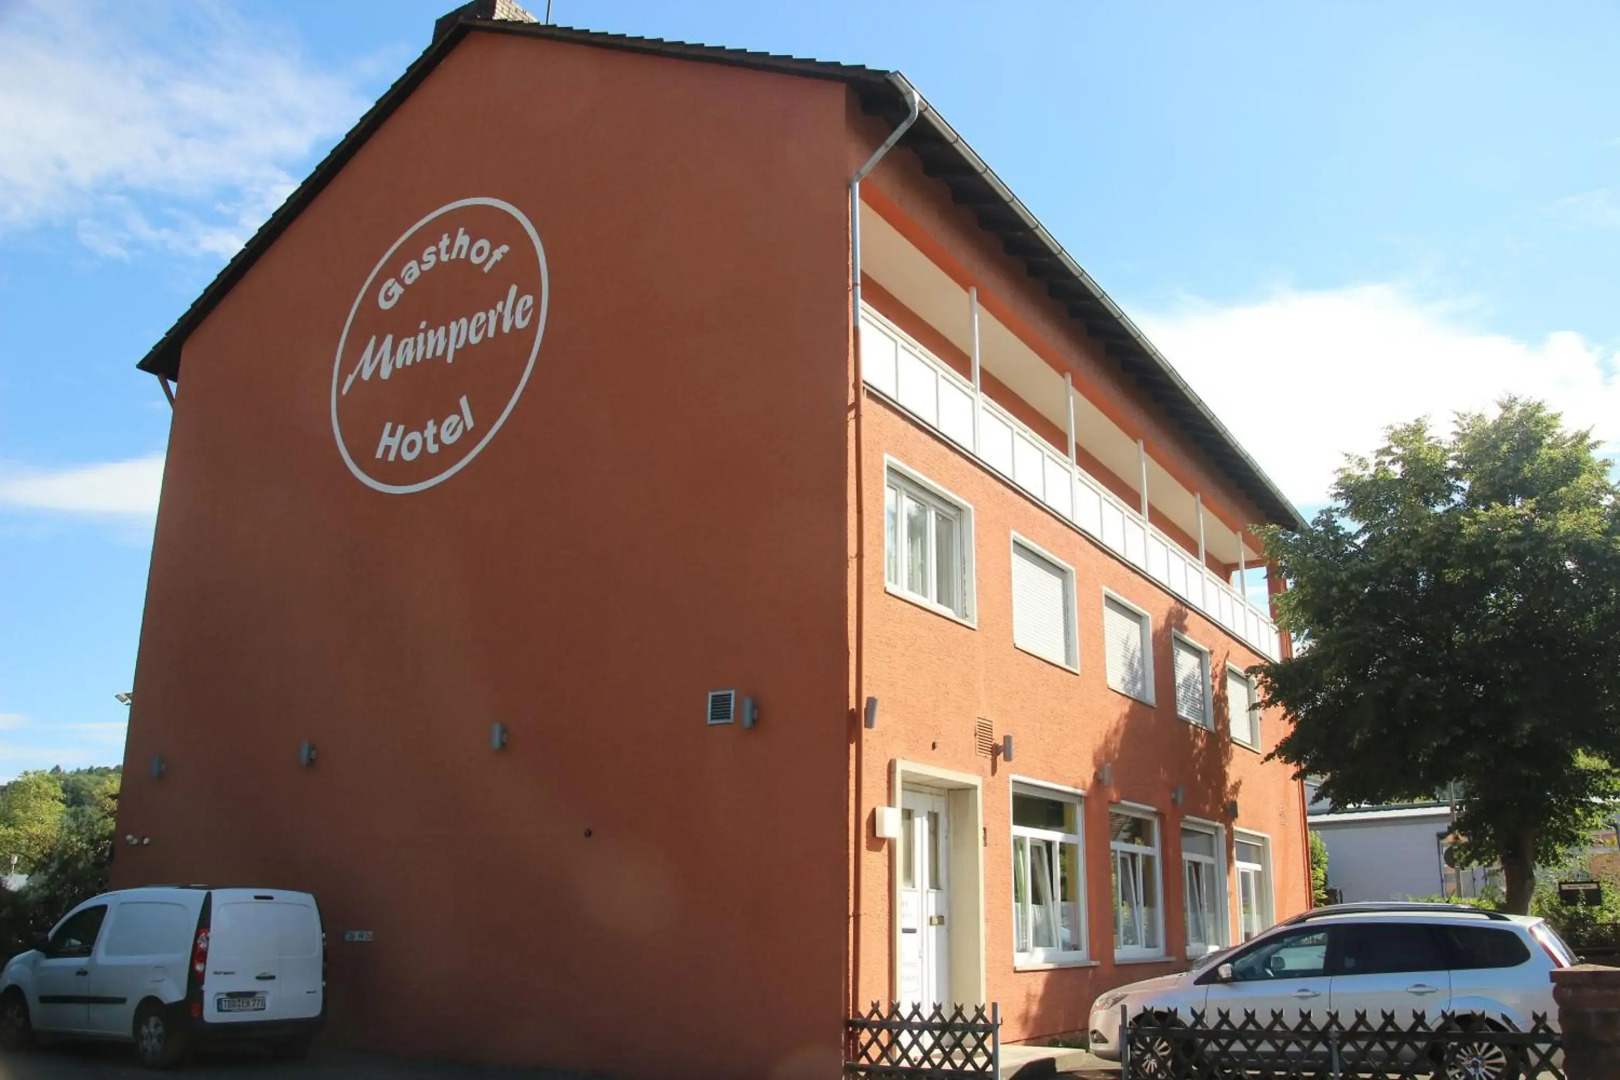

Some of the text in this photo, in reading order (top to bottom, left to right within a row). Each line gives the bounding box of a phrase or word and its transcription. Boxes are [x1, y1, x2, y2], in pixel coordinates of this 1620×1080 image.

[378, 228, 510, 309] Gasthof
[342, 284, 533, 395] Mainperle
[376, 395, 474, 461] Hotel
